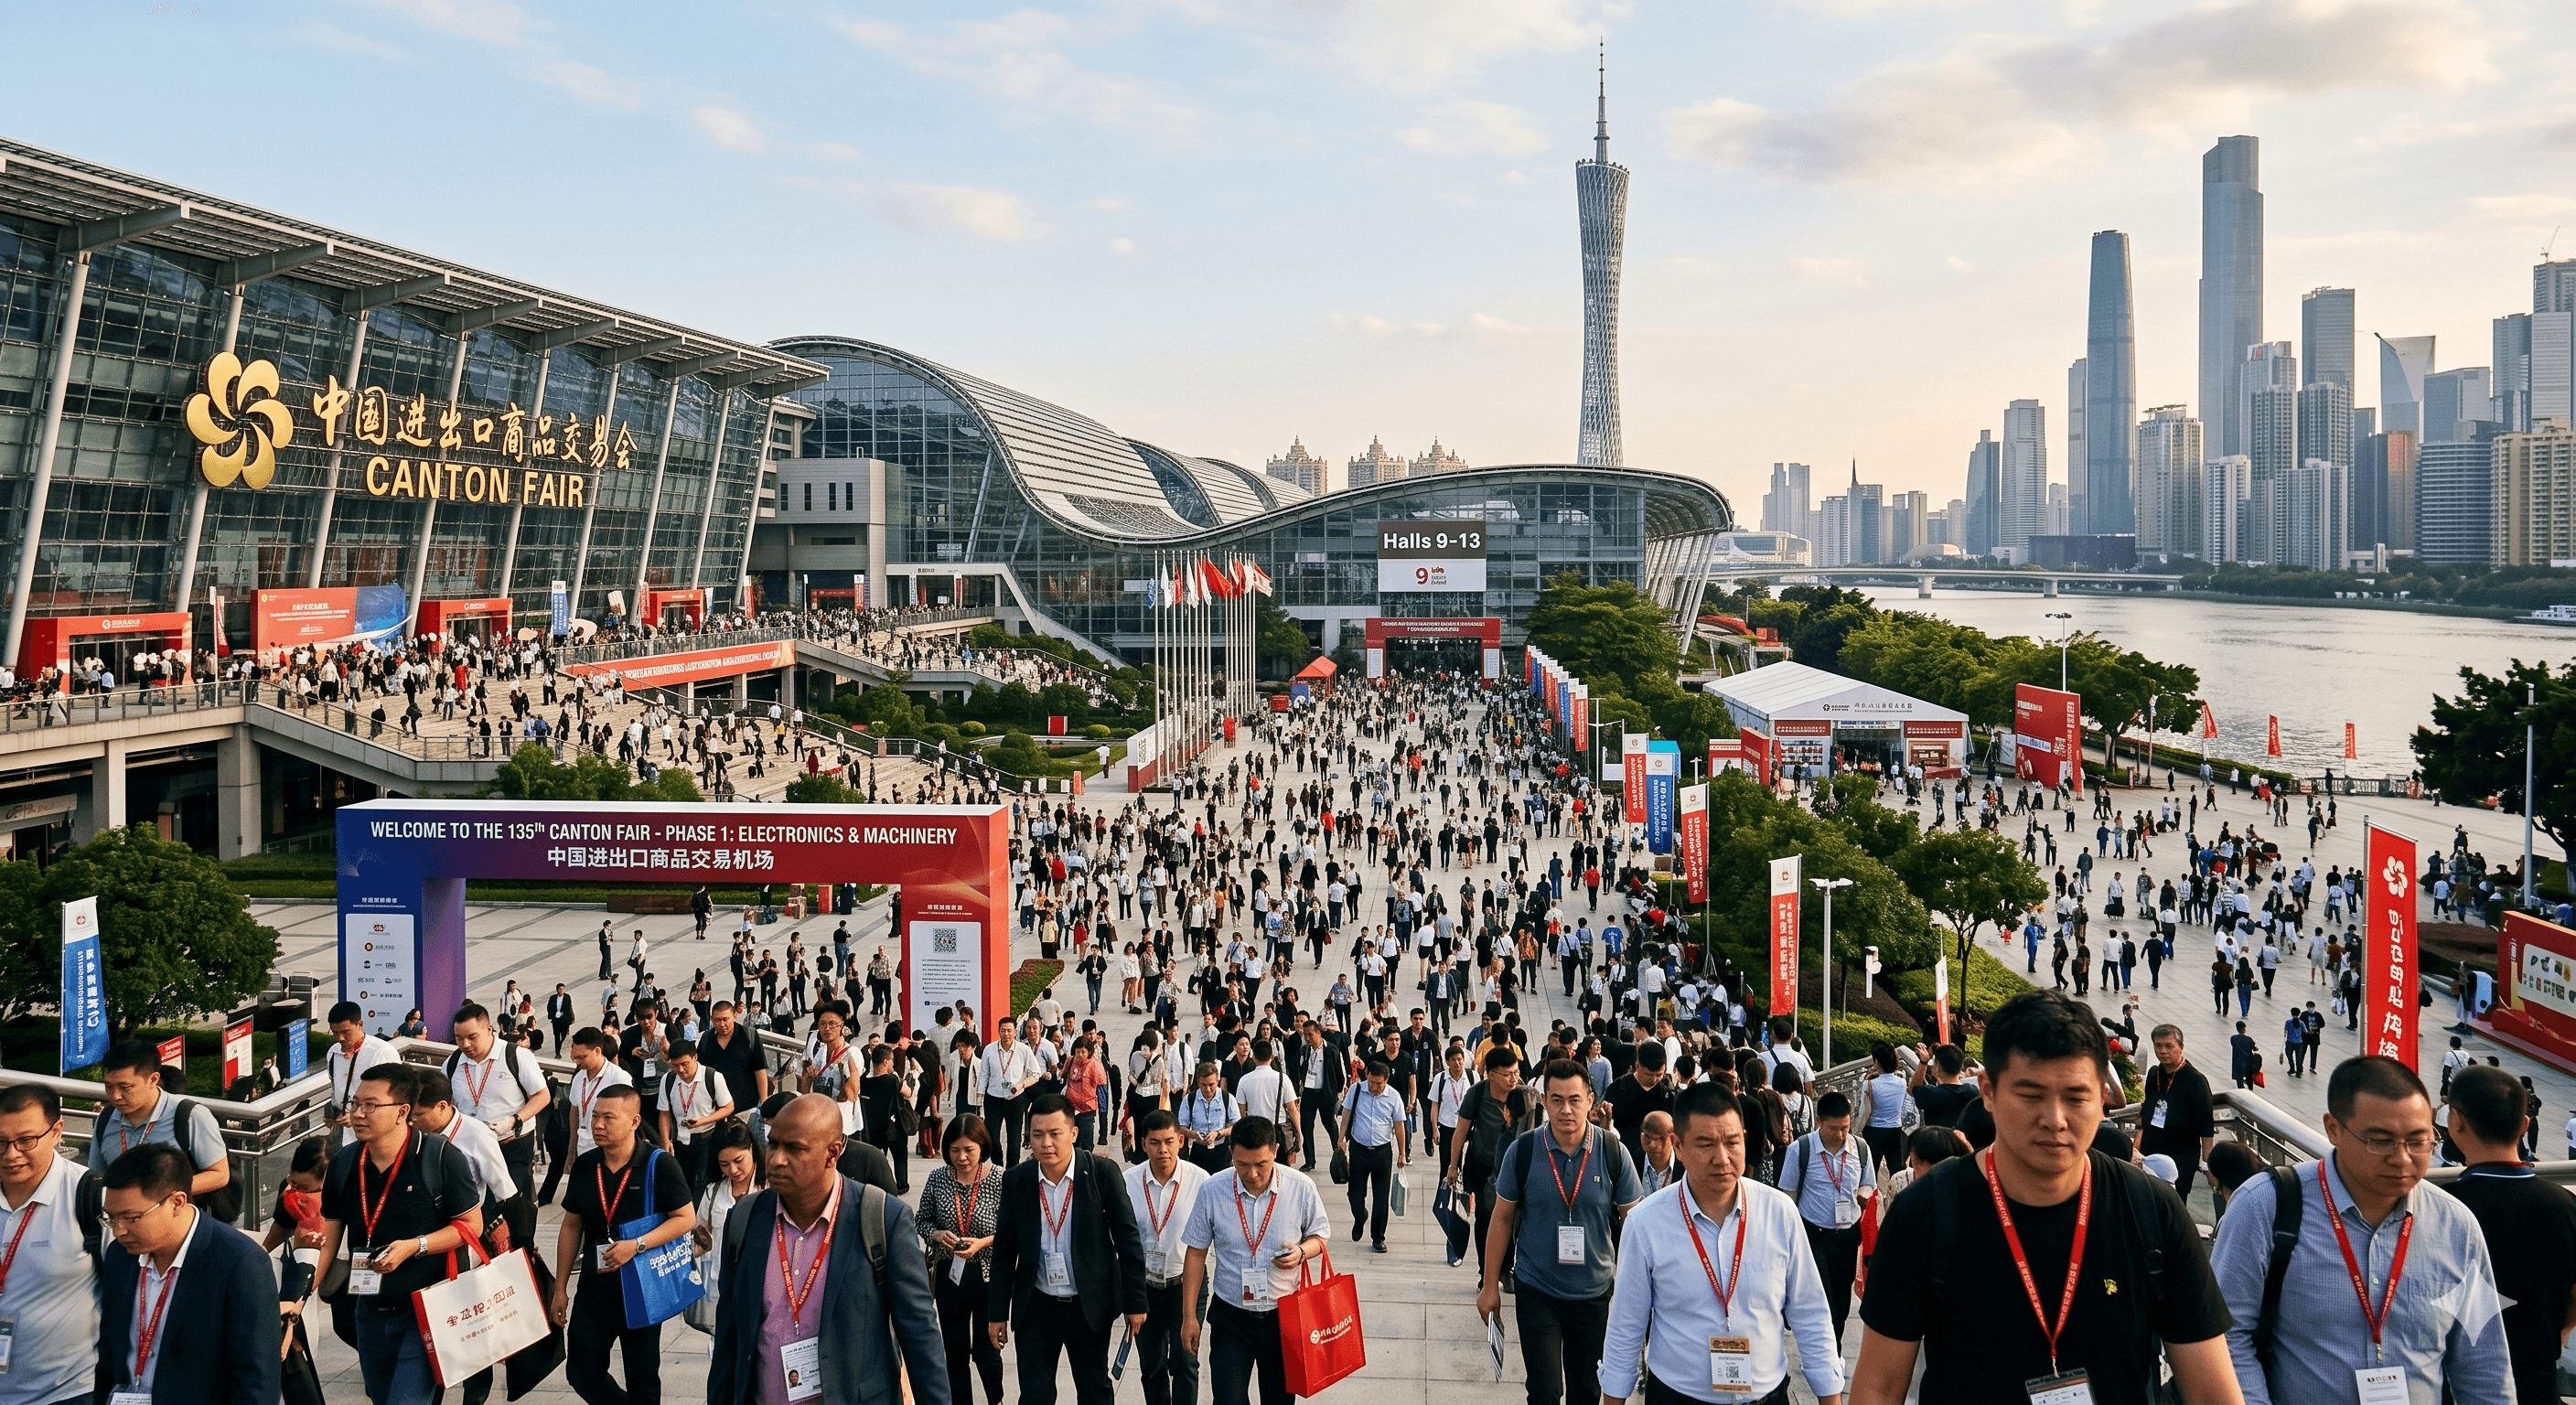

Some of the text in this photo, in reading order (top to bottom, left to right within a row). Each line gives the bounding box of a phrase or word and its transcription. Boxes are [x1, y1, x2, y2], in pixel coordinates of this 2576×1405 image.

[313, 374, 639, 470] 中国进出口商品交易会
[365, 456, 584, 508] CANTON FAIR
[1383, 532, 1481, 549] Halls 9-13
[1415, 567, 1429, 585] 9
[370, 821, 446, 838] WELCOME
[449, 822, 470, 839] TO
[473, 822, 503, 840] THE
[508, 821, 545, 840] 135th
[549, 823, 612, 841] CANTON
[617, 824, 650, 841] FAIR
[665, 825, 716, 842] PHASE
[720, 825, 735, 842] 1:
[738, 826, 844, 843] ELECTRONICS
[848, 827, 860, 843] &
[864, 827, 958, 844] MACHINERY
[547, 846, 775, 870] 中国进出口商品交易机场
